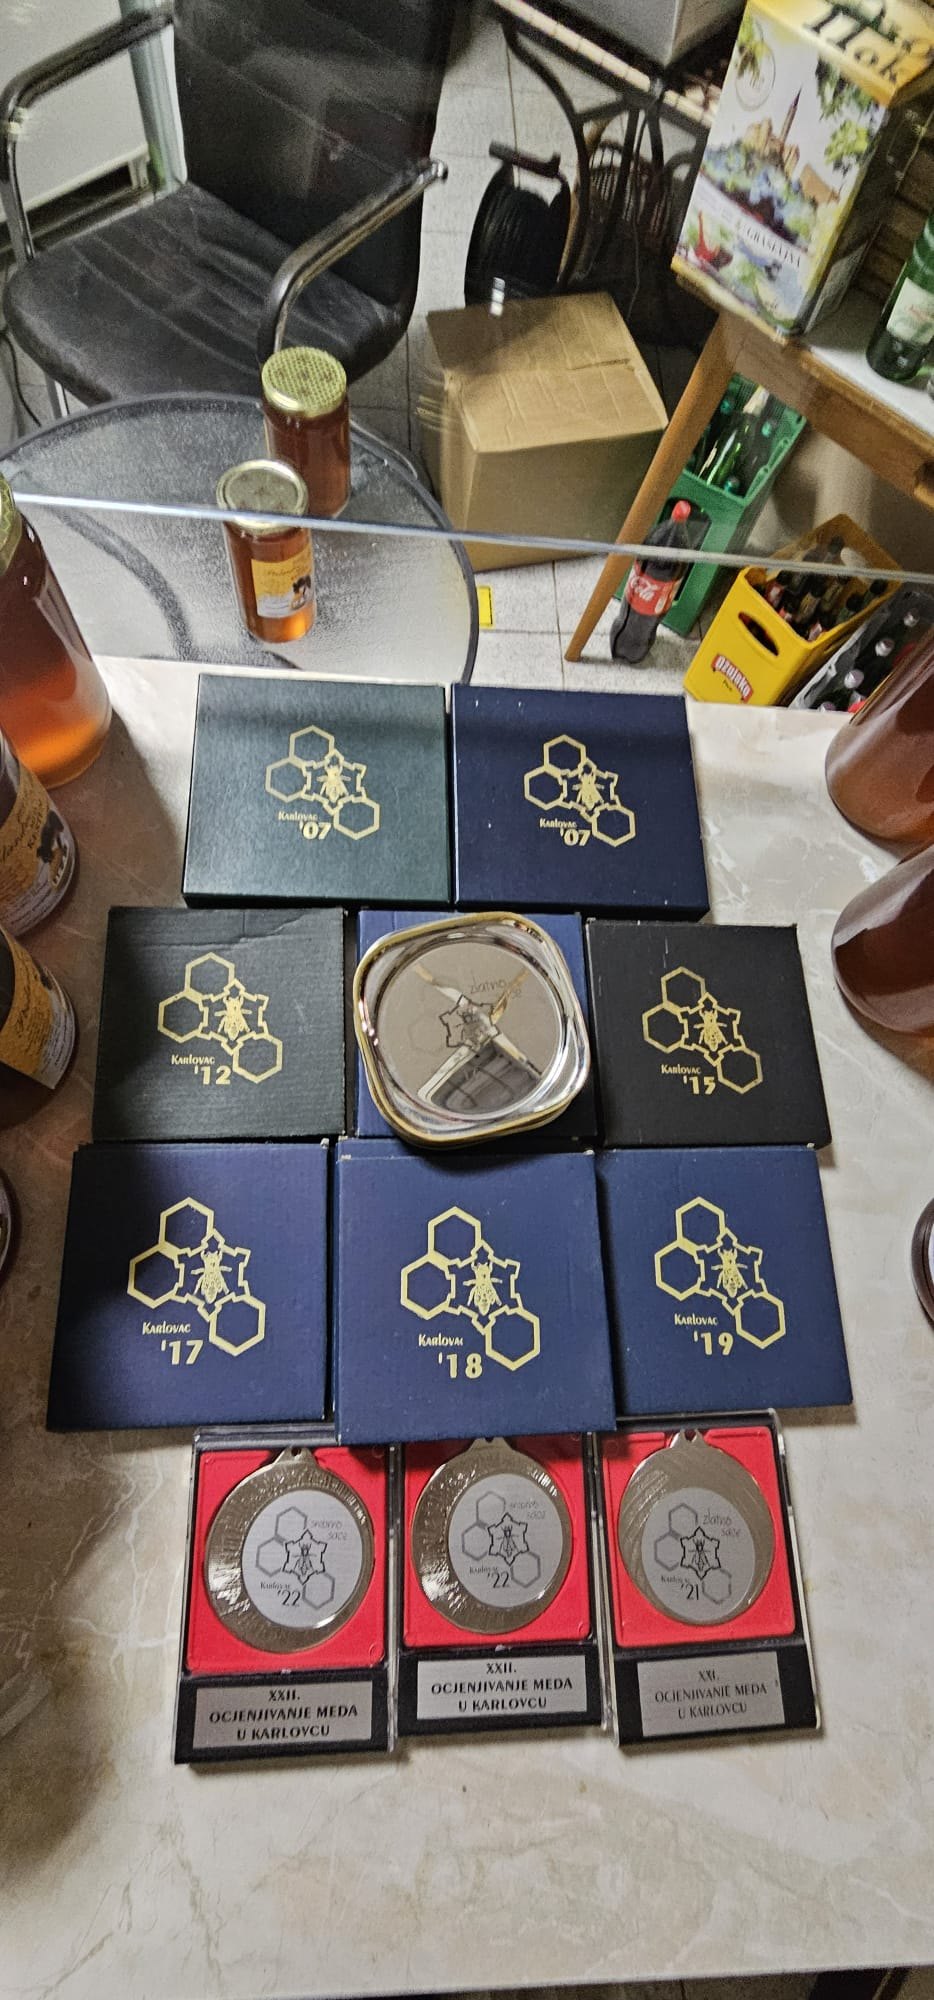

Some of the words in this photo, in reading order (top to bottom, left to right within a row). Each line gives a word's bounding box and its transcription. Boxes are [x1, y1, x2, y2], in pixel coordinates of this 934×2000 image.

[299, 820, 332, 840] '07
[560, 828, 591, 847] '07
[194, 1064, 232, 1085] '12
[682, 1074, 716, 1095] '15
[693, 1330, 734, 1356] '19
[161, 1339, 204, 1366] '17
[438, 1352, 483, 1379] '18
[487, 1571, 509, 1588] '22
[277, 1589, 301, 1606] '22
[680, 1584, 699, 1600] '21
[486, 1662, 517, 1674] XXII.
[431, 1680, 529, 1695] OCJENJIVANJE
[534, 1677, 573, 1691] MEDA
[735, 1683, 767, 1696] MEDA
[268, 1689, 300, 1701] XXII.
[458, 1701, 467, 1712] U
[473, 1697, 547, 1712] KARLOVCU
[678, 1708, 686, 1719] U
[690, 1703, 747, 1718] KARLOVCU
[209, 1706, 312, 1724] OCJENJIVANJE
[316, 1704, 358, 1718] MEDA
[236, 1729, 247, 1741] U
[251, 1725, 330, 1740] KARLOVCU
